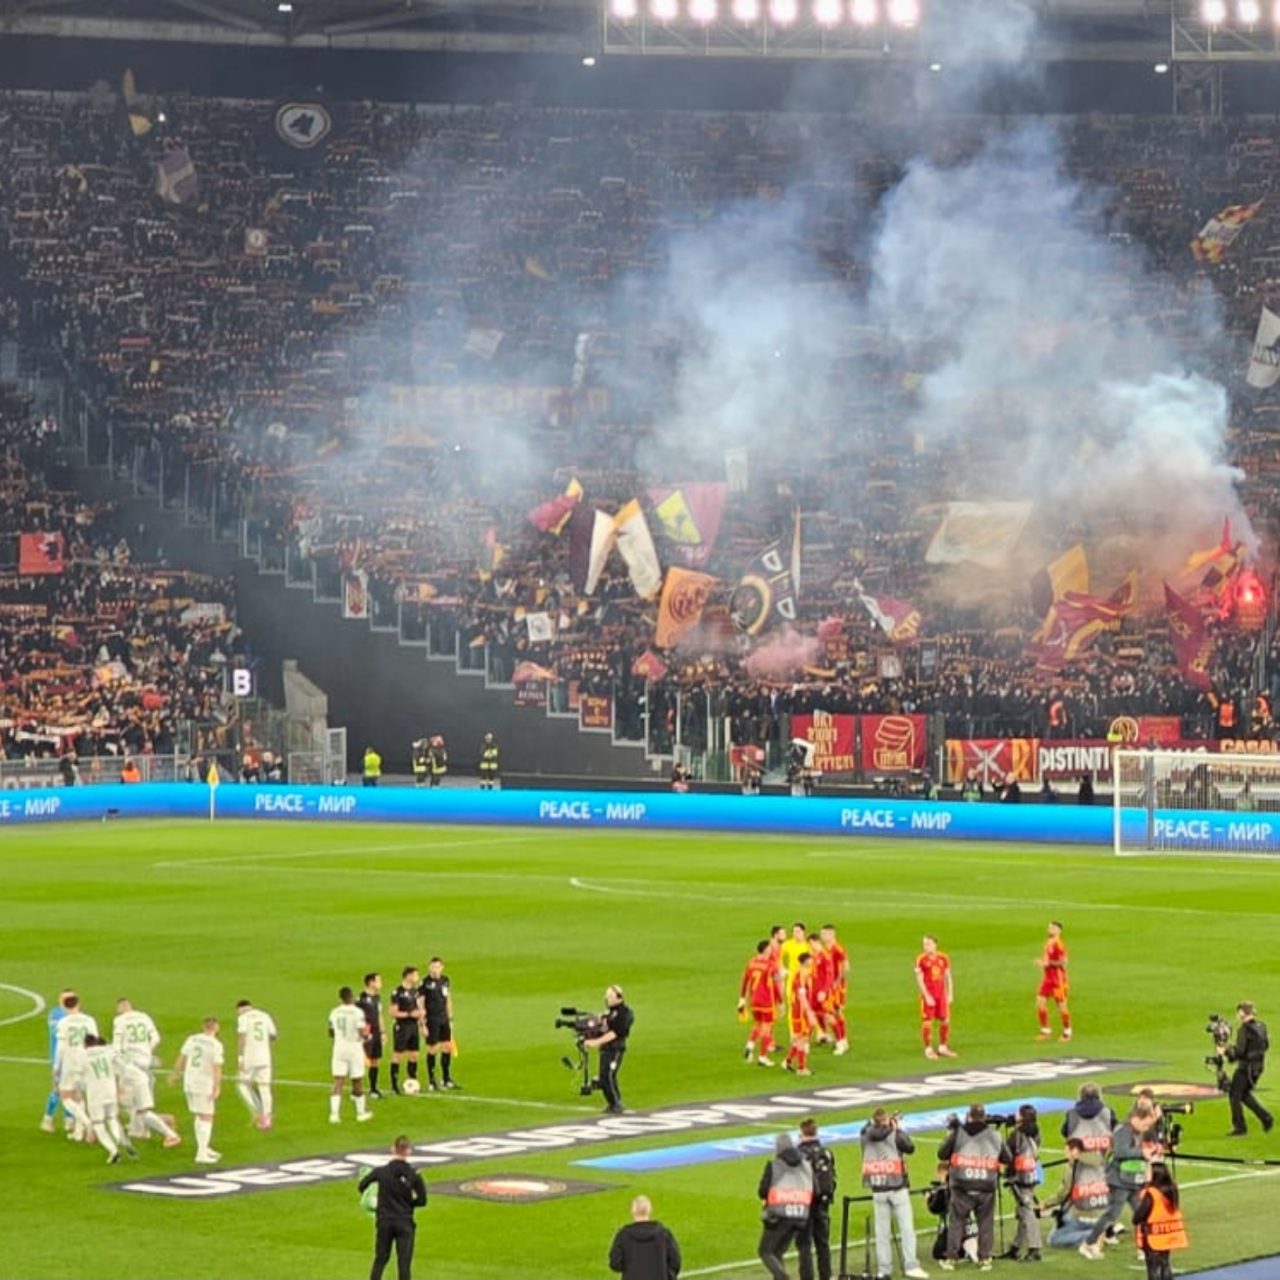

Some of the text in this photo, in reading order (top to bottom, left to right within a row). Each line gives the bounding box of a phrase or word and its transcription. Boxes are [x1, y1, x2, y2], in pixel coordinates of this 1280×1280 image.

[233, 669, 250, 696] B
[1039, 746, 1110, 771] DISTINTI
[256, 799, 302, 812] PEACE
[541, 804, 590, 819] PEACE
[842, 808, 893, 827] PEACE
[1154, 819, 1209, 838] PEACE
[127, 1022, 147, 1044] 33
[254, 1019, 265, 1042] 5
[190, 1045, 202, 1068] 2
[416, 1104, 812, 1157] EUROPA
[770, 1059, 1108, 1108] LEAGUE
